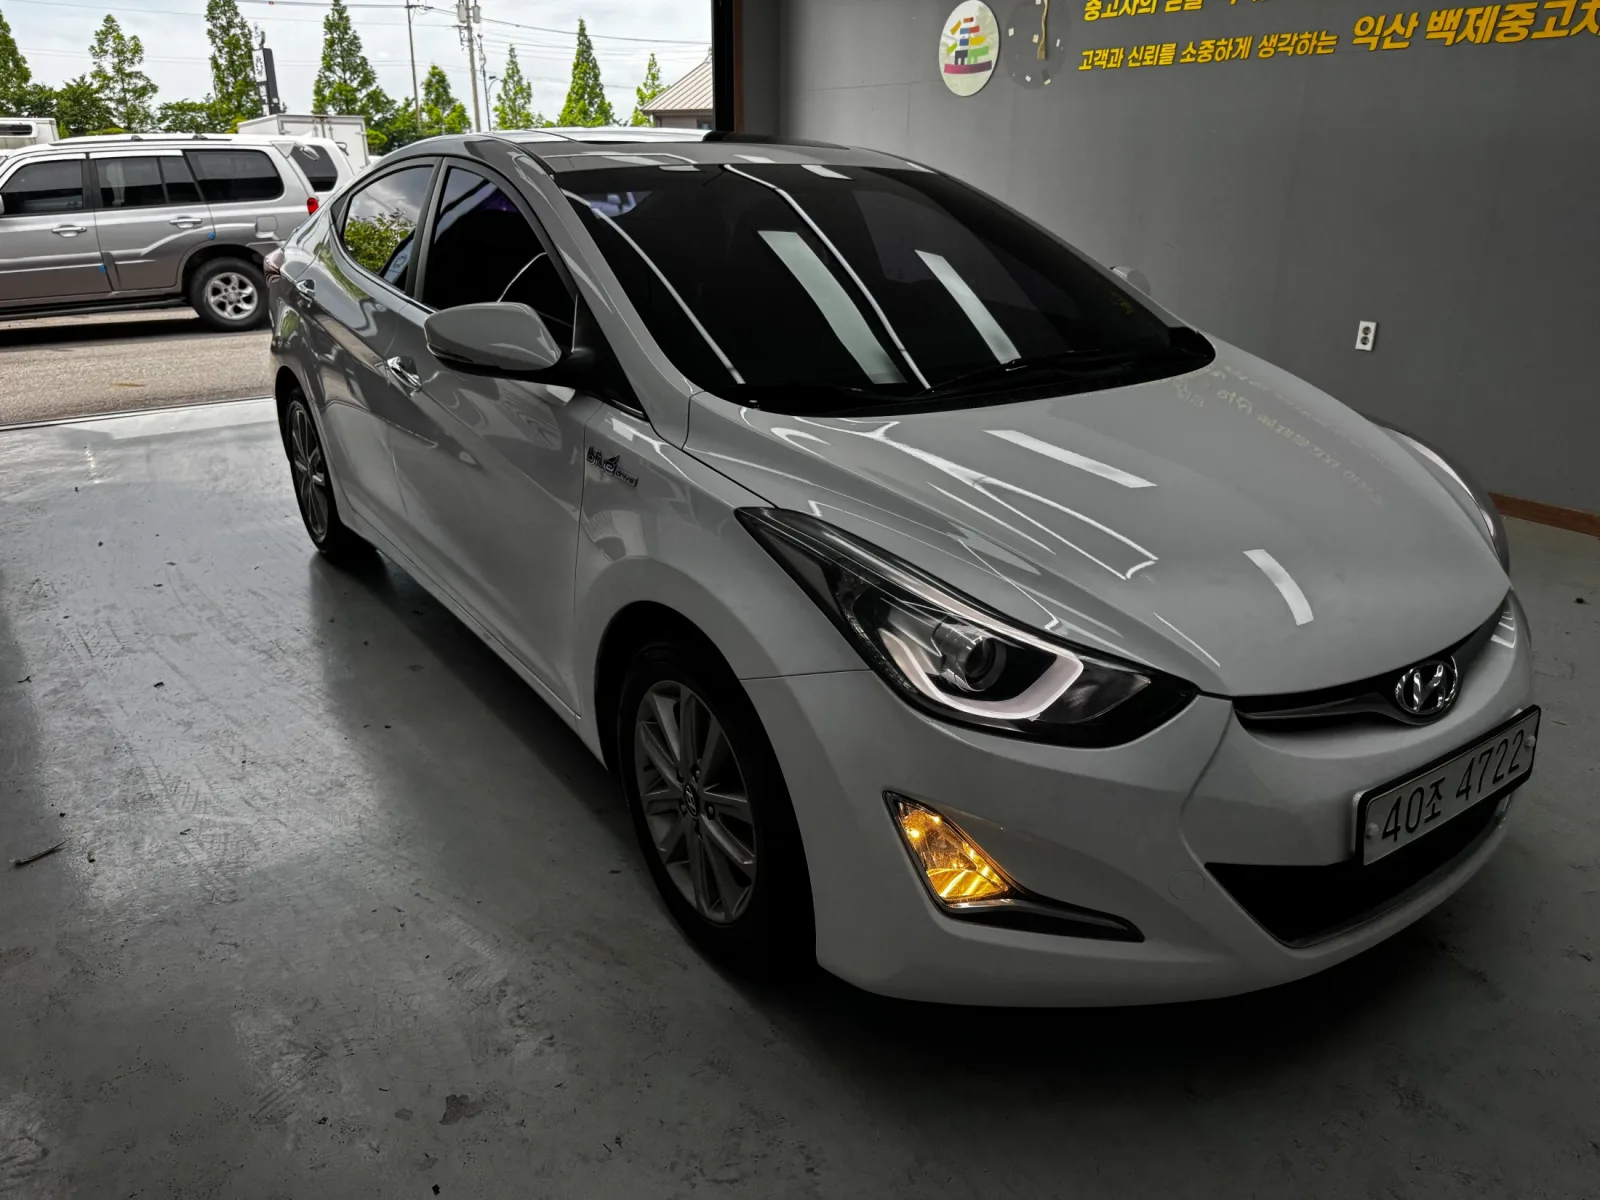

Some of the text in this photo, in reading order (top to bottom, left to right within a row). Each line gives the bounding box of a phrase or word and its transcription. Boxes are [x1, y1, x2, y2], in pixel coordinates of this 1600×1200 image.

[1078, 47, 1124, 71] 고객과
[1127, 42, 1177, 68] 신뢰를
[1179, 36, 1253, 64] 소중하게
[1257, 31, 1338, 58] 생각하는
[1352, 12, 1420, 51] 익산
[1381, 728, 1525, 842] 40조 4722
